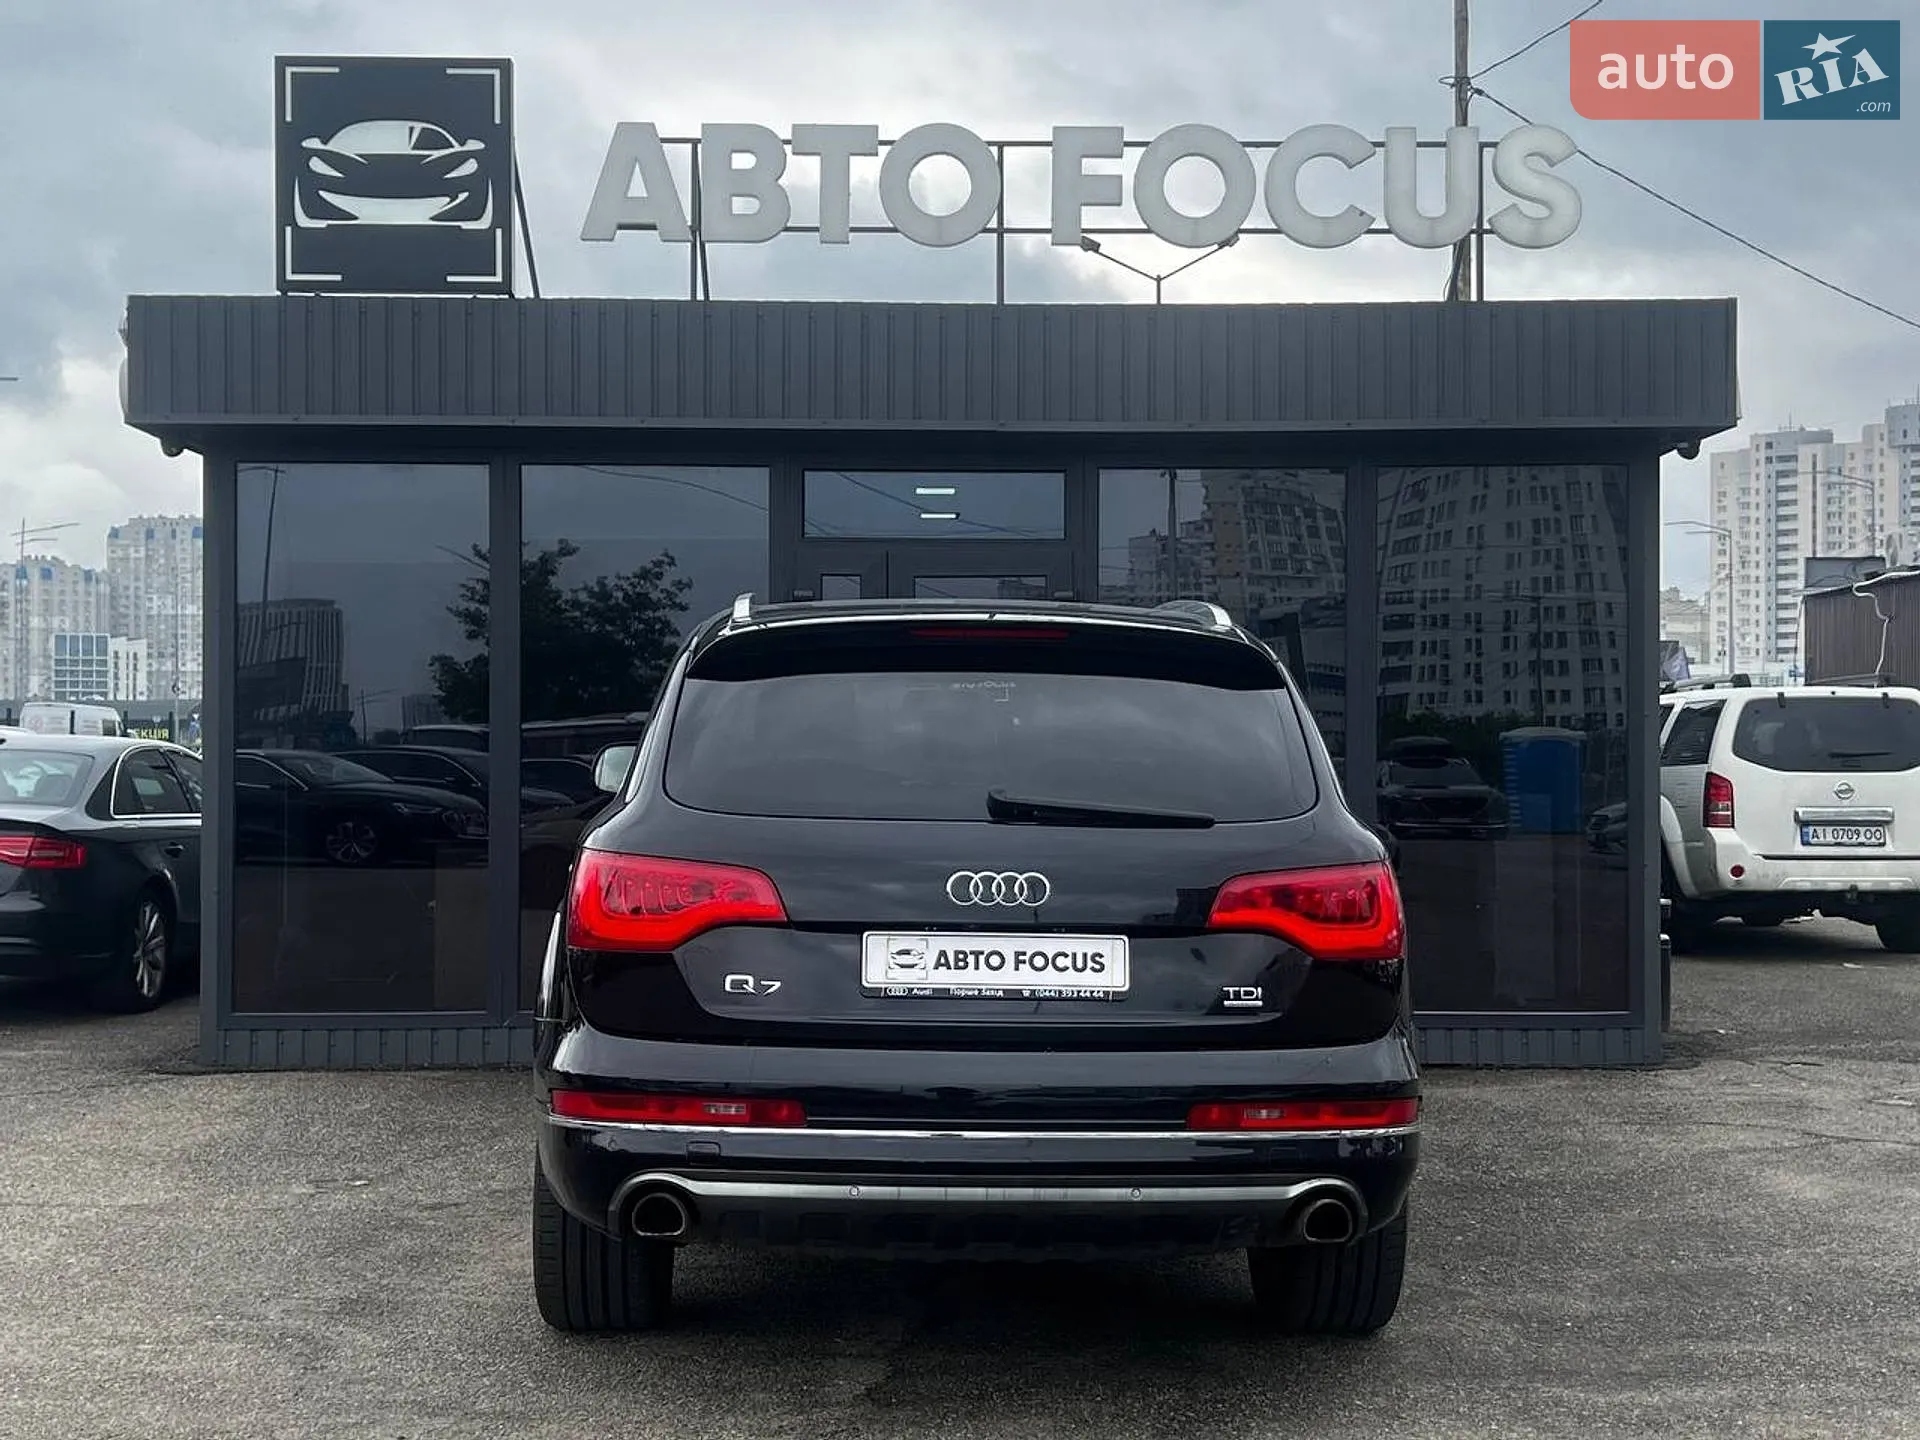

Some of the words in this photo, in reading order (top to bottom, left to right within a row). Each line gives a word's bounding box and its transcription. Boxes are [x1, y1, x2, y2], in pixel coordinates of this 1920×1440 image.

[580, 121, 1001, 247] АВТО
[1051, 122, 1582, 249] FOCUS
[1832, 828, 1861, 840] 0709
[932, 949, 1007, 972] АВТО
[1014, 950, 1106, 974] FOCUS
[724, 974, 782, 996] Q7
[1222, 986, 1263, 999] TDI
